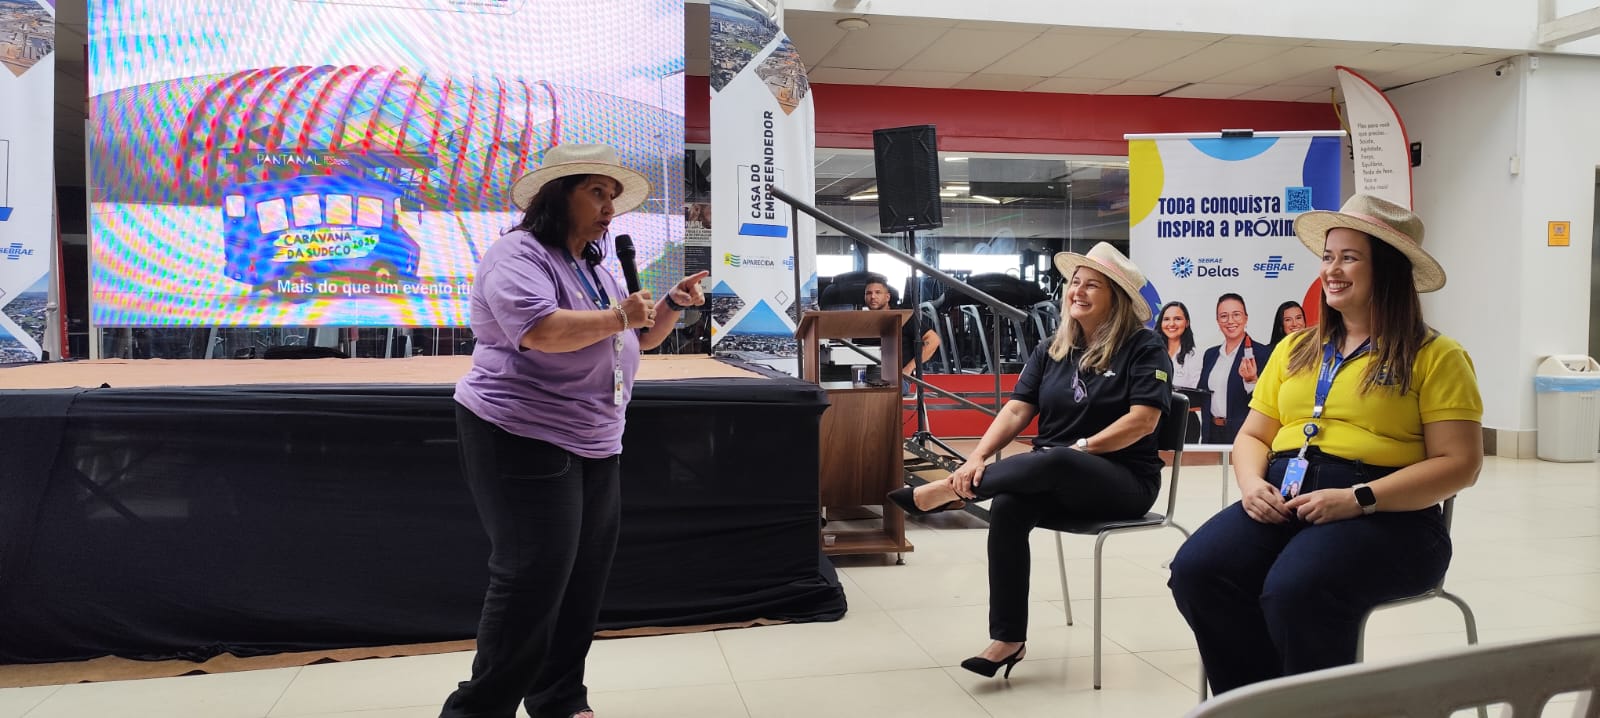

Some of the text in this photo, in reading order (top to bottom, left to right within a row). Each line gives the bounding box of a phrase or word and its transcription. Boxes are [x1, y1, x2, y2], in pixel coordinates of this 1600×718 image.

[257, 153, 321, 166] PANTANAL
[763, 110, 775, 220] EMPREENDEDOR
[750, 164, 761, 219] CASA DO
[1158, 195, 1281, 216] TODA CONQUISTA
[1234, 216, 1297, 238] PRÓXIM
[284, 231, 377, 250] CARAVANA 2026
[287, 245, 351, 260] DA SUDECO
[742, 258, 775, 266] APARECIDA
[1252, 263, 1295, 271] SEBRAE
[1197, 265, 1240, 278] Delas
[277, 279, 314, 294] Mais
[318, 280, 338, 294] do
[342, 283, 371, 297] que
[376, 283, 398, 294] um
[402, 281, 453, 295] evento
